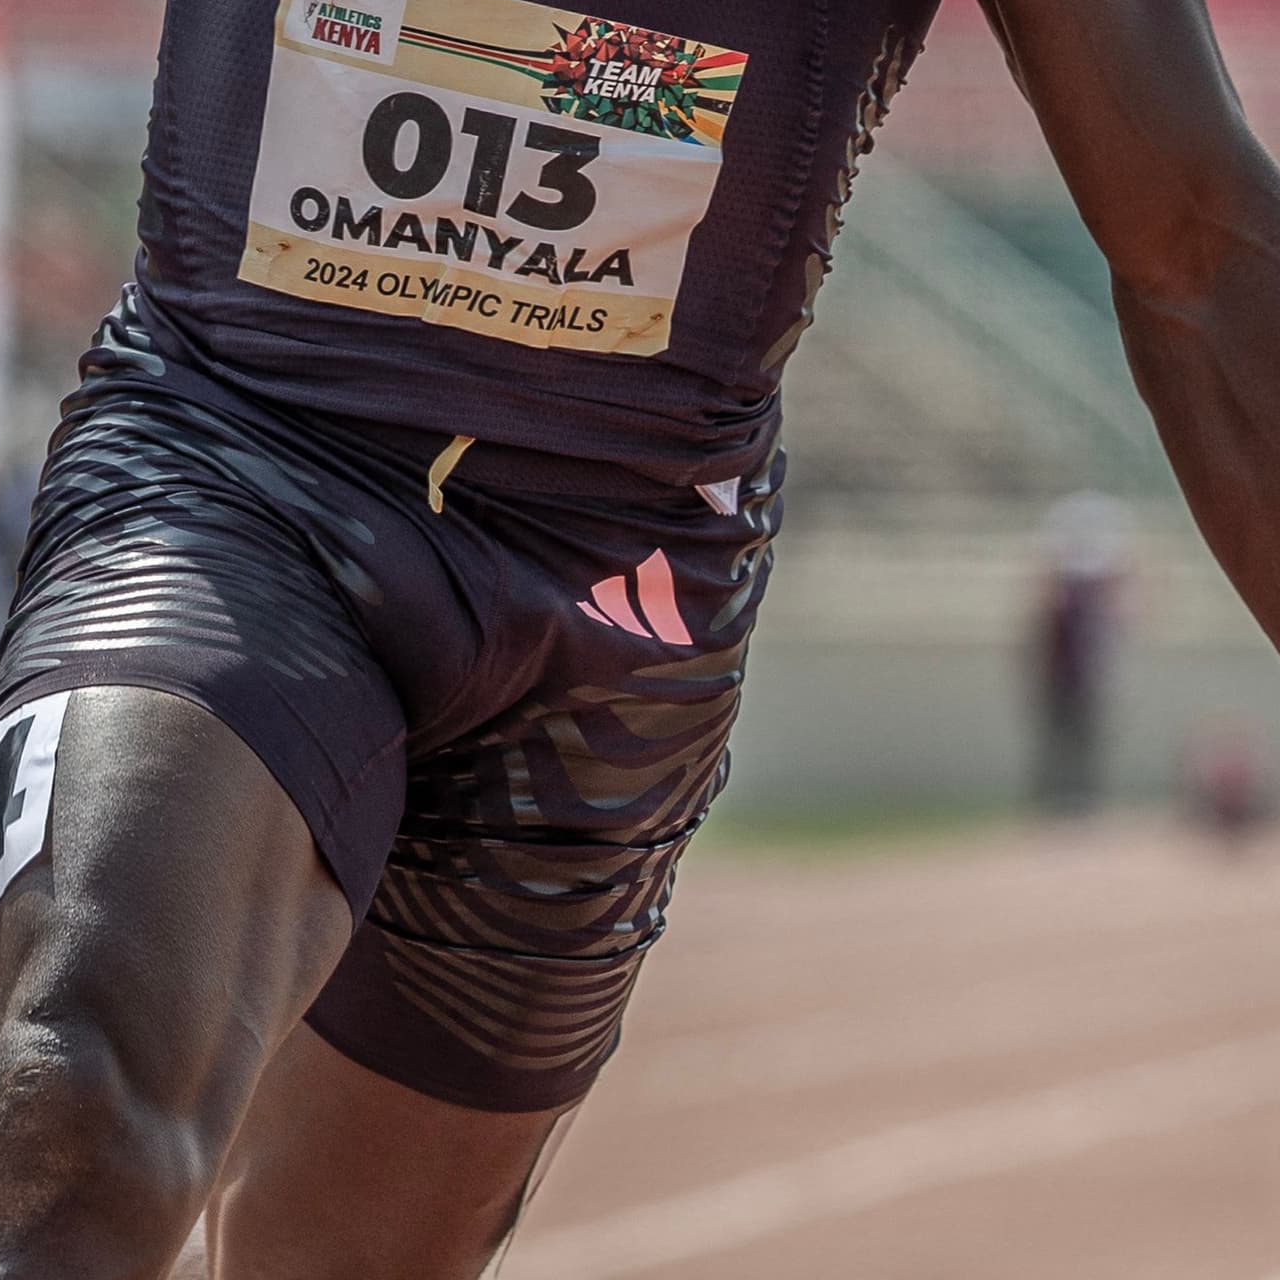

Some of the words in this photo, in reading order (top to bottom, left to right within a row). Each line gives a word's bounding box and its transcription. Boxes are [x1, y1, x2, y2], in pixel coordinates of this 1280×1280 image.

[318, 3, 383, 30] ATHLETICS
[312, 17, 381, 55] KENYA
[588, 57, 663, 85] TEAM
[583, 78, 657, 104] KENYA
[362, 91, 601, 231] 013
[290, 186, 635, 287] OMANYALA
[303, 257, 369, 292] 2024
[376, 272, 502, 318] OLYMPIC
[510, 303, 608, 332] TRIALS
